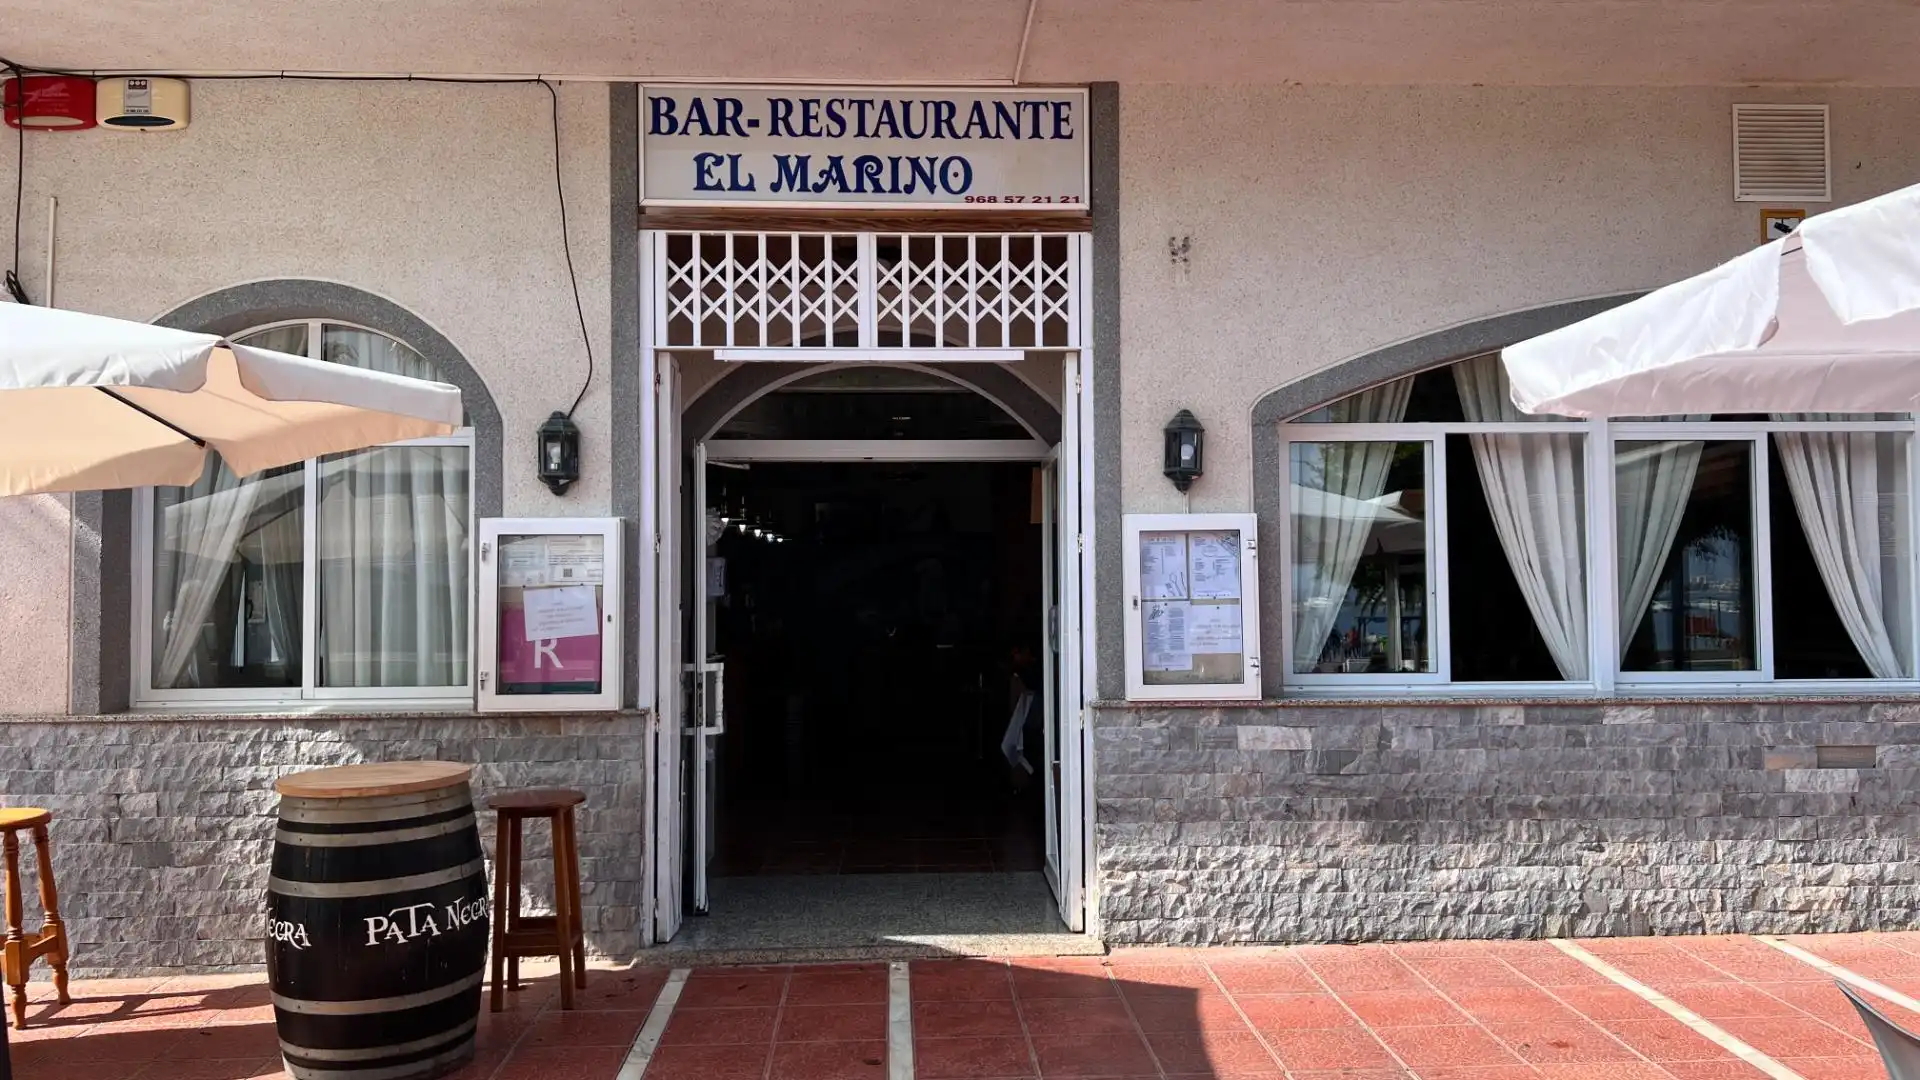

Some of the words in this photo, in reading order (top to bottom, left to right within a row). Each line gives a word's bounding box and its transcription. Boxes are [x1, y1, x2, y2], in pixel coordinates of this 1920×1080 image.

[693, 152, 756, 193] EL
[770, 155, 973, 195] MARINO
[964, 195, 998, 204] 968
[1004, 195, 1026, 204] 57
[1032, 195, 1053, 204] 21
[1060, 195, 1081, 204] 21
[267, 907, 312, 950] EGRA
